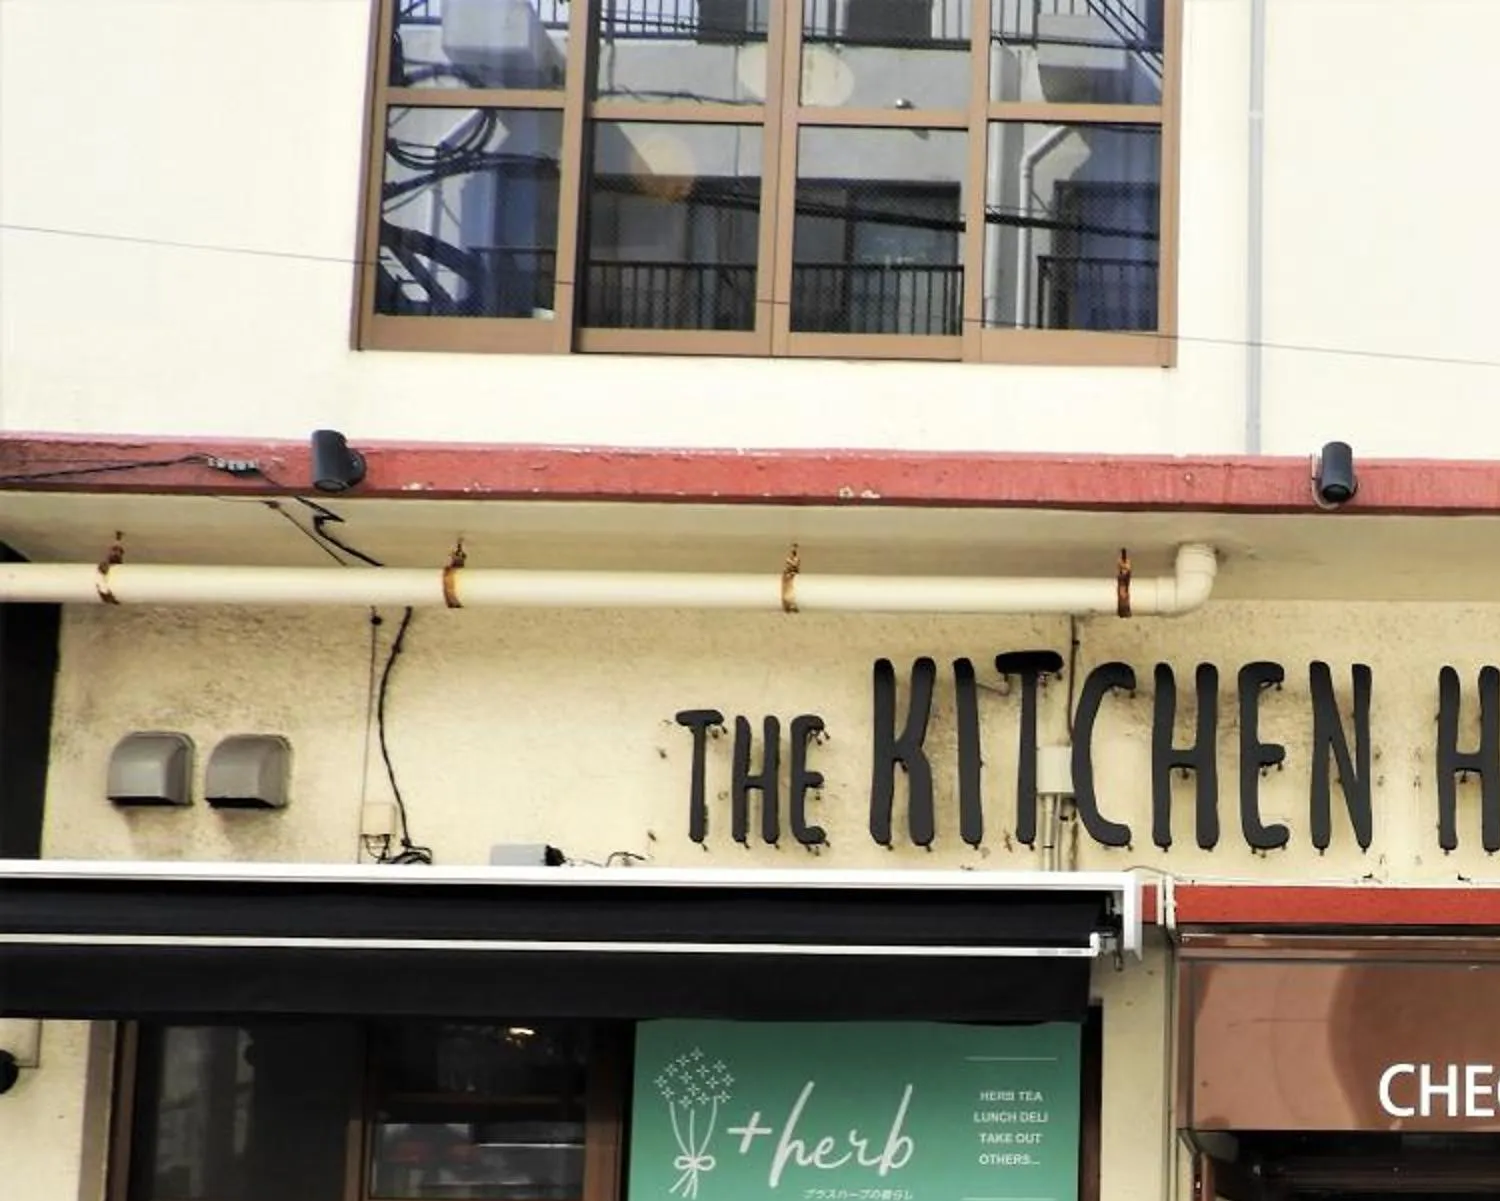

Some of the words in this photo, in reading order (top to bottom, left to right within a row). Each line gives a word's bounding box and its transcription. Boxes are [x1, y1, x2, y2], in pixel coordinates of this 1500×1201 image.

[675, 709, 827, 846] THE
[869, 650, 1373, 850] KITCHEN
[979, 1090, 1015, 1102] HERB
[1018, 1090, 1044, 1102] TEA
[973, 1110, 1017, 1123] LUNCH
[1020, 1110, 1049, 1123] DELI
[979, 1132, 1013, 1144] TAKE
[1015, 1132, 1044, 1144] OUT
